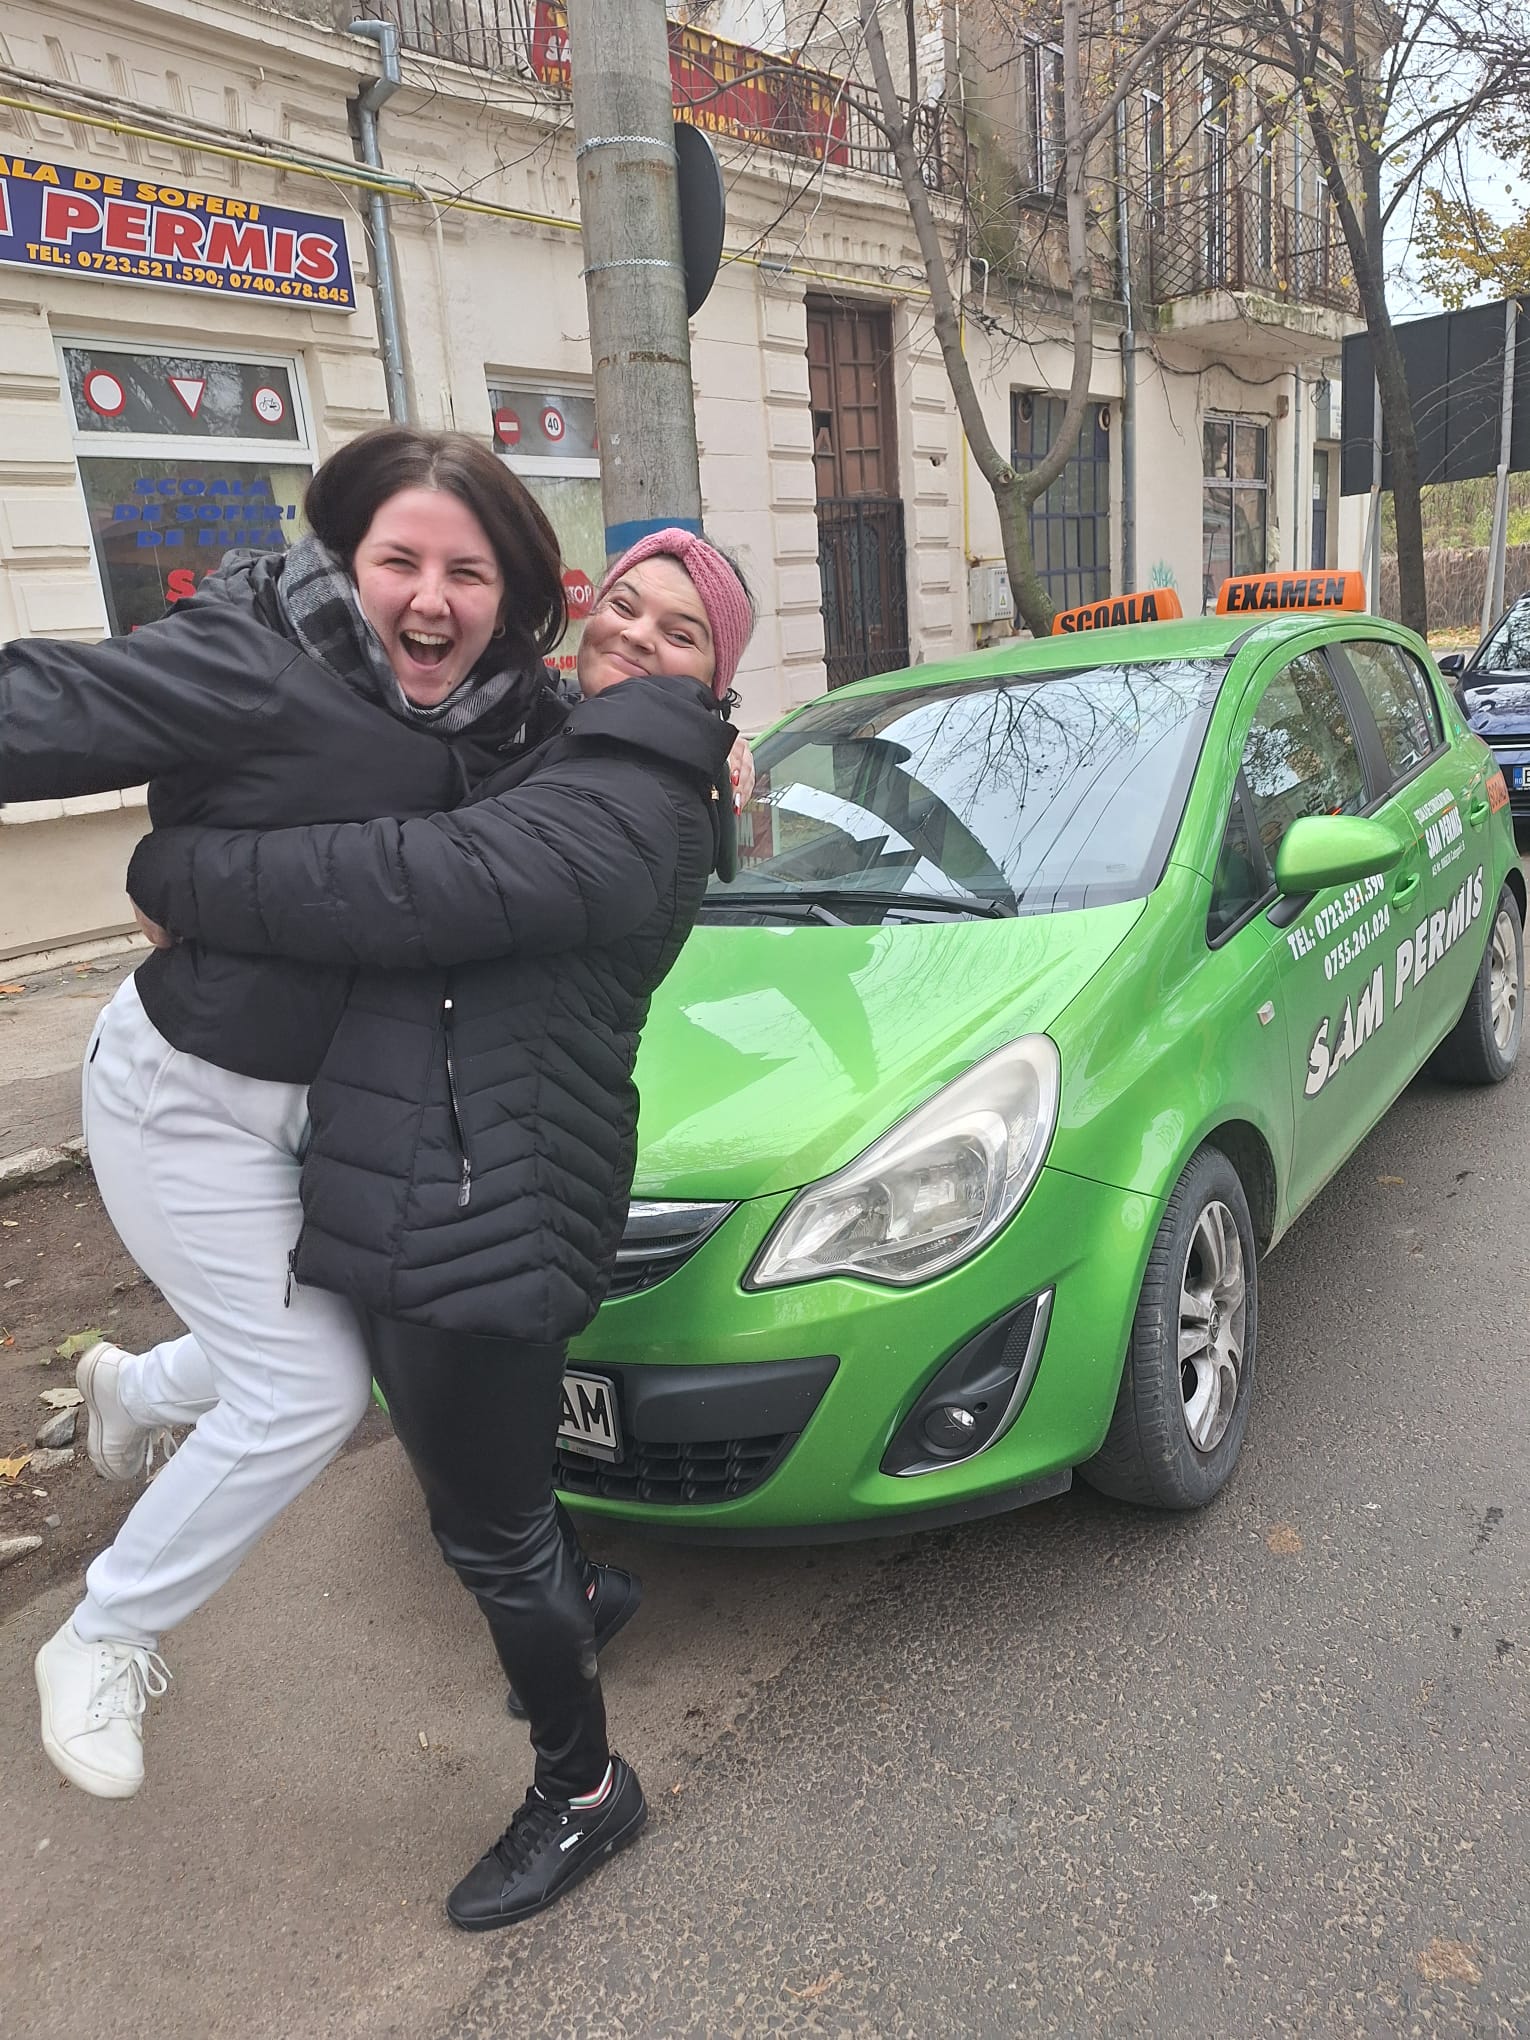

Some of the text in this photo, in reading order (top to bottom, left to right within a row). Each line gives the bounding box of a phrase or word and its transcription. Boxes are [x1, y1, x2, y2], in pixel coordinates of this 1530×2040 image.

[74, 170, 123, 196] DE
[136, 183, 260, 221] SOFERI
[41, 186, 339, 283] PERMIS
[26, 243, 349, 303] TEL: 0723.521.590; 0740.678.845
[547, 416, 559, 431] 40
[134, 479, 269, 497] SCOALA
[113, 504, 297, 521] DE SOFERI
[137, 529, 184, 548] DE
[1060, 595, 1159, 633] SCOALA
[1227, 577, 1346, 611] EXAMEN
[1287, 872, 1385, 960] TEL: 0723.521.590
[1324, 903, 1390, 980] 0755.261.024
[1304, 864, 1484, 1099] SAM PERMIS
